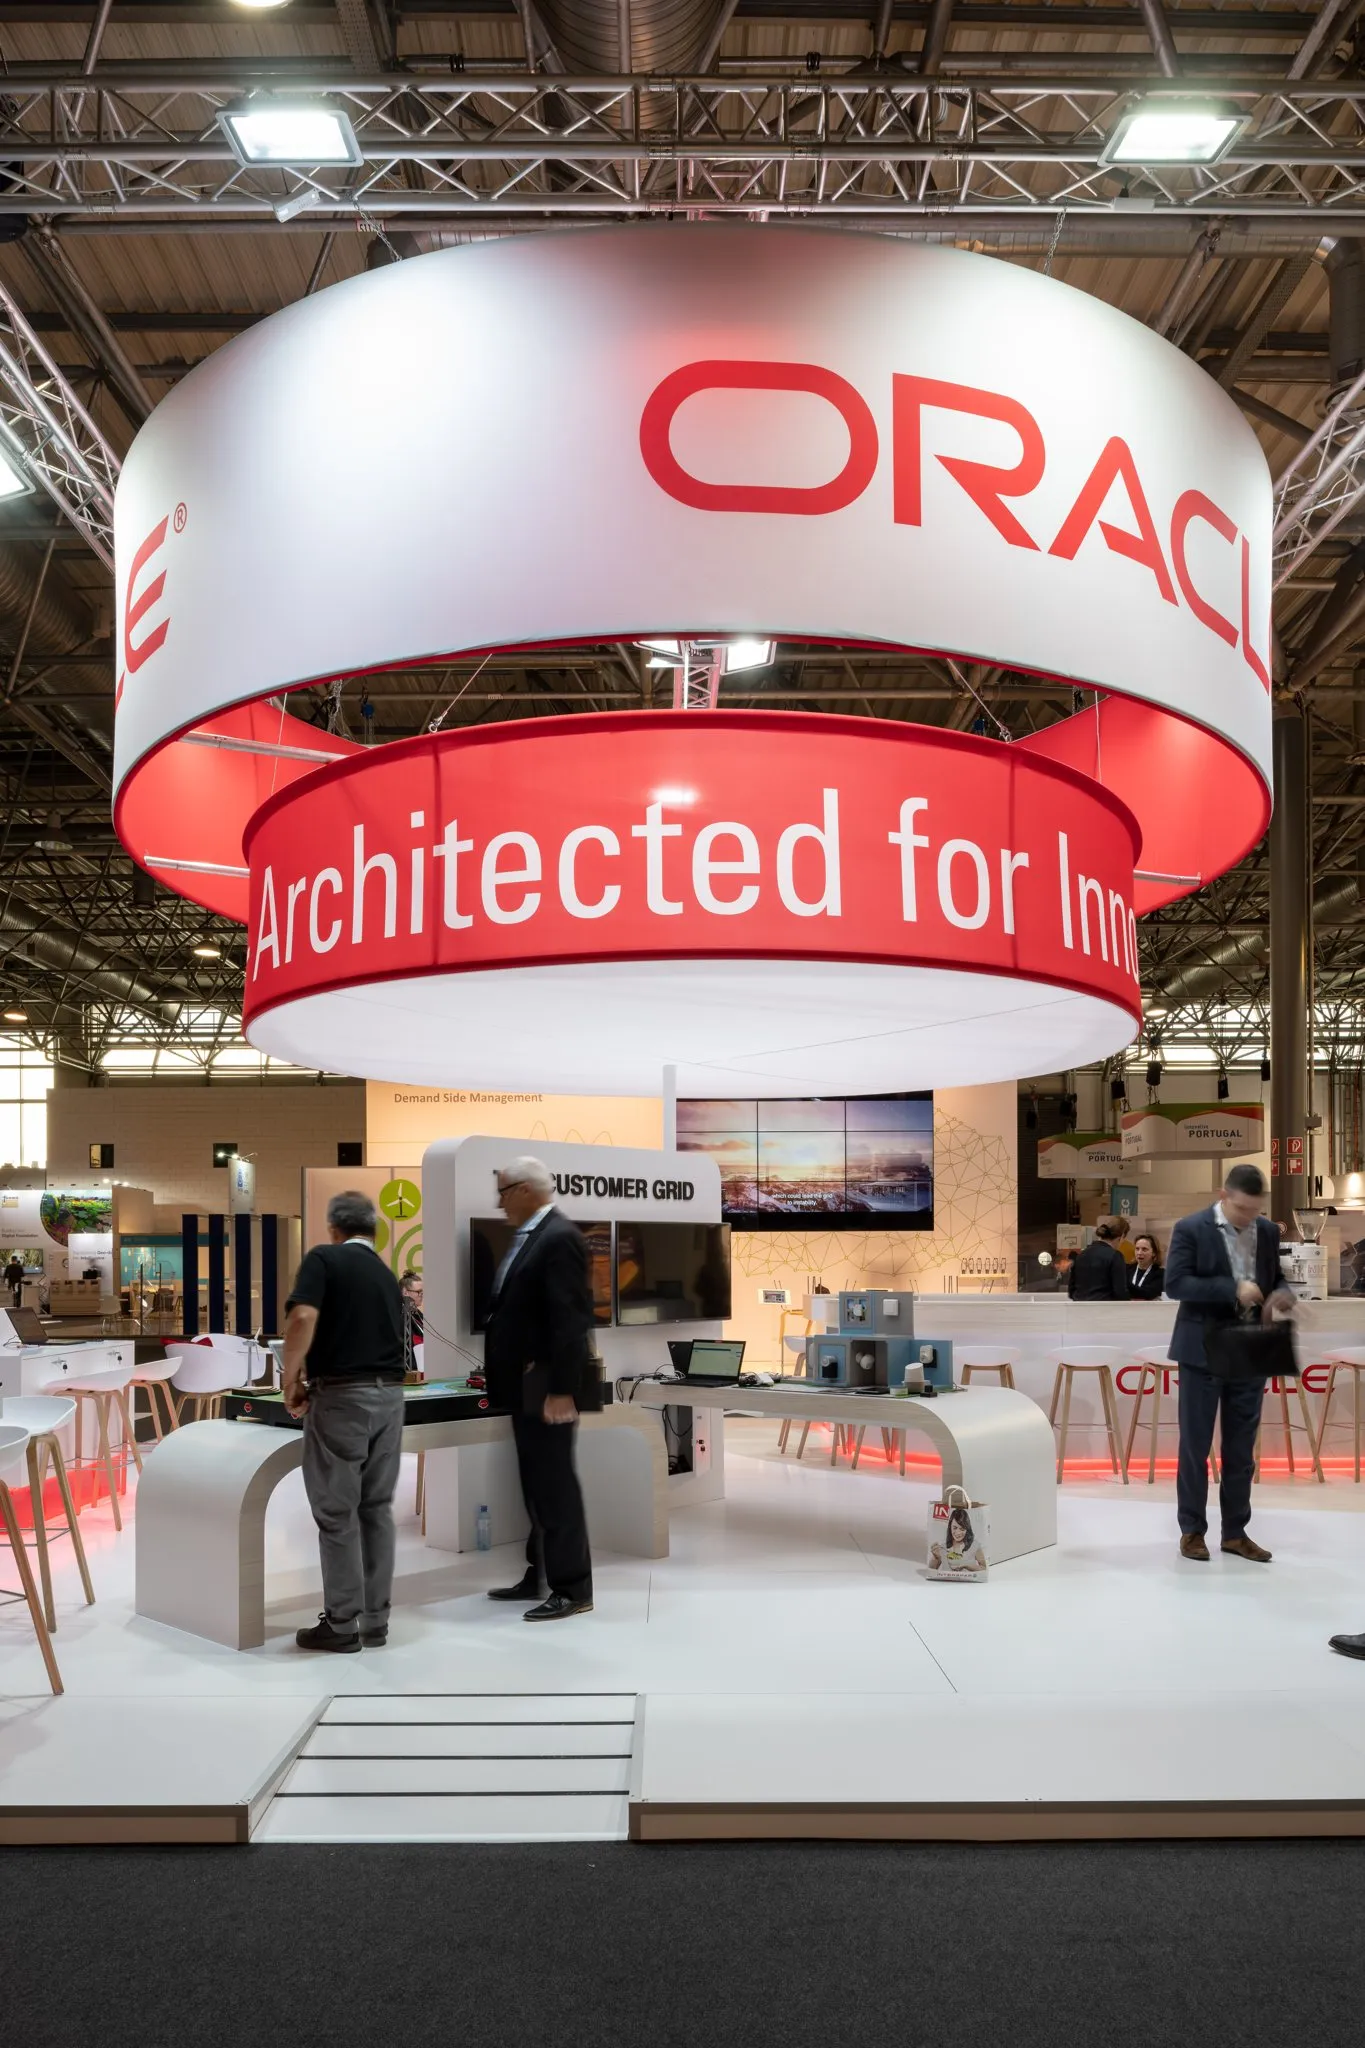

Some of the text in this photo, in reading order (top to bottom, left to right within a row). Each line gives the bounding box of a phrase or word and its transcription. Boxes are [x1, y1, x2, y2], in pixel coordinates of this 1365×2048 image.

[640, 360, 1273, 697] ORACL
[253, 787, 842, 982] Architected
[888, 796, 1030, 935] for
[394, 1092, 543, 1105] Demand Side Management
[1188, 1129, 1243, 1138] PORTUGAL
[652, 1179, 695, 1201] GRID
[934, 1506, 949, 1517] IN
